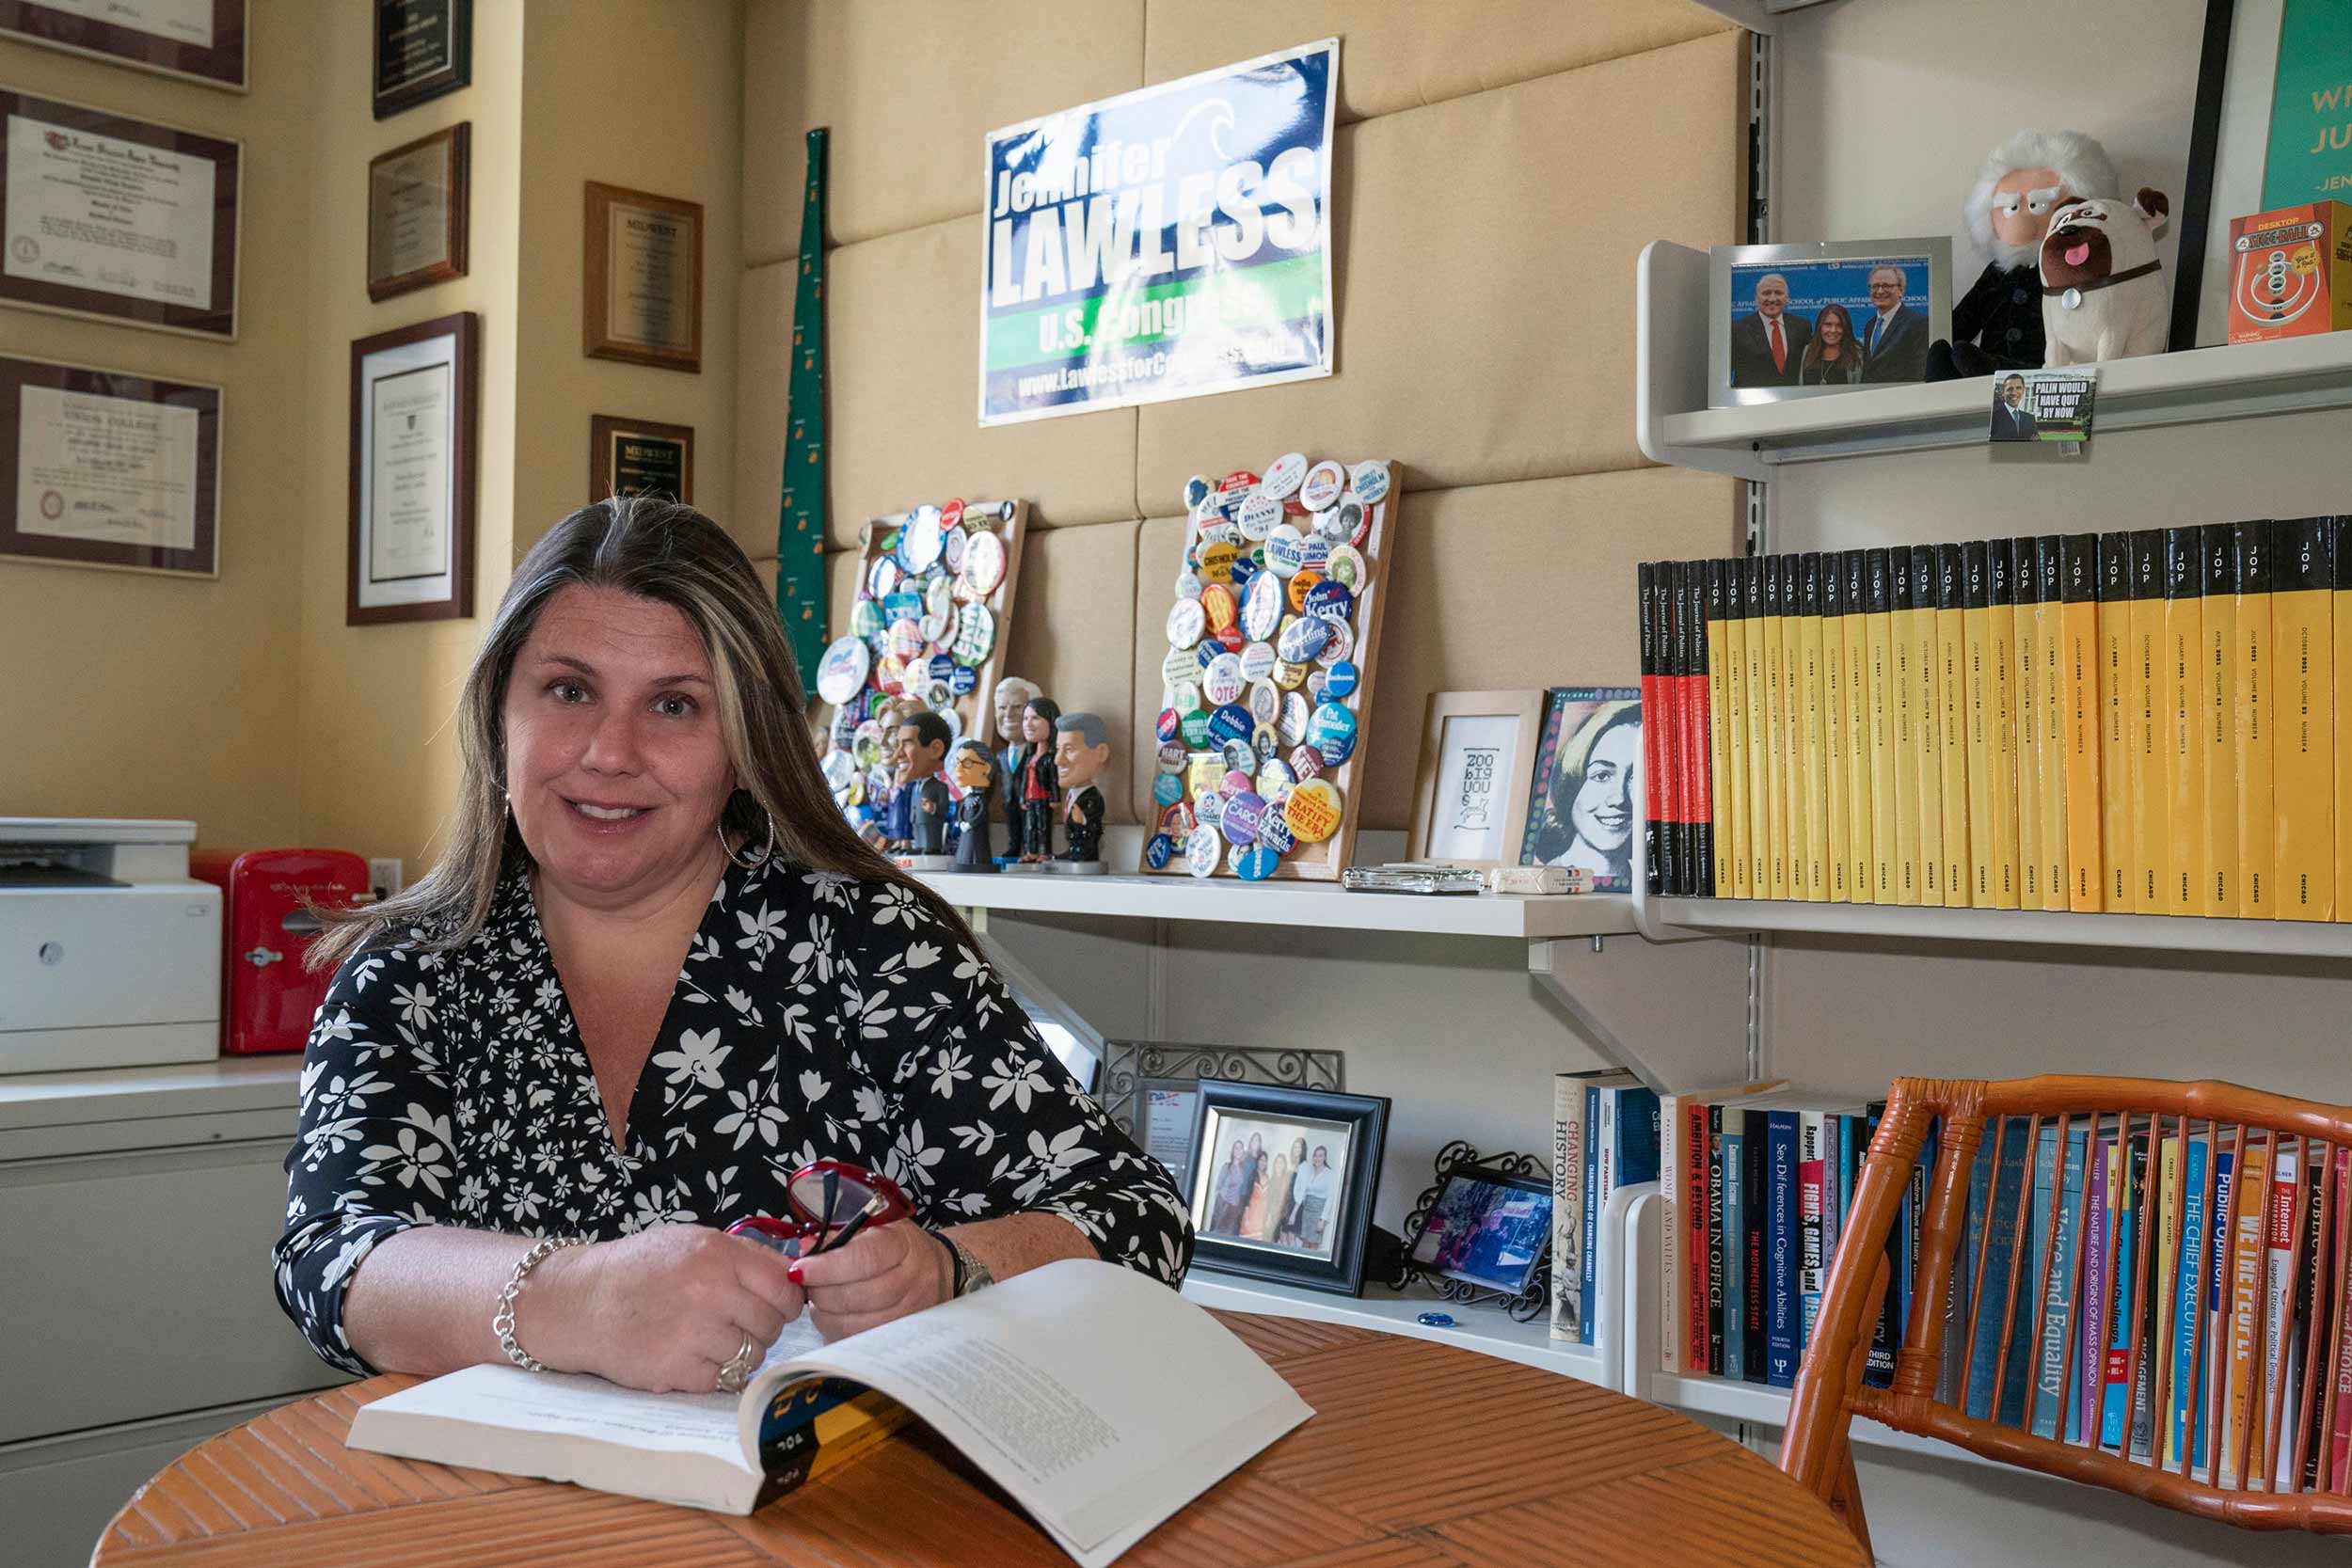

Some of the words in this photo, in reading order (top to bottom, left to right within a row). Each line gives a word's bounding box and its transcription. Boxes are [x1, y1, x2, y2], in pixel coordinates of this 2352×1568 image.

[993, 137, 1174, 217] Jennifer
[993, 147, 1321, 309] LAWLESS
[2258, 218, 2299, 231] DESKTOP
[1039, 308, 1091, 355] U.S.
[2036, 383, 2058, 393] PALIN
[2058, 382, 2088, 393] WOULD
[2040, 395, 2060, 406] HAVE
[2061, 394, 2081, 406] QUIT
[2043, 408, 2055, 419] BY
[2055, 407, 2075, 419] NOW
[1204, 552, 1237, 566] CHISHOLM
[1308, 542, 1327, 550] PAUL
[1305, 600, 1348, 618] Kerry
[1309, 592, 1328, 603] John
[1220, 709, 1247, 732] Debbie
[1263, 806, 1291, 839] Kerry
[1287, 807, 1304, 823] THE
[1306, 820, 1325, 838] ERA
[1293, 800, 1331, 827] RATIFY
[1258, 819, 1292, 852] Edwards
[1692, 1114, 1702, 1168] AMBITION
[1777, 1144, 1787, 1161] Sex
[1804, 1126, 1817, 1161] Rapoport
[1555, 1120, 1566, 1200] HISTORY
[1566, 1121, 1579, 1201] CHANGING
[1587, 1164, 1596, 1192] CHANGING
[1664, 1165, 1673, 1200] WOMEN
[1710, 1165, 1721, 1223] OBAMA
[1692, 1186, 1703, 1229] BEYOND
[1804, 1183, 1819, 1225] FIGHTS,
[2091, 1195, 2100, 1214] THE
[2187, 1193, 2201, 1221] THE
[2216, 1173, 2231, 1221] Public
[1664, 1210, 1673, 1231] AND
[2090, 1216, 2099, 1245] NATURE
[2240, 1216, 2259, 1242] WE
[2270, 1194, 2279, 1242] GENERATION
[2280, 1196, 2292, 1243] Internet
[1710, 1227, 1722, 1244] IN
[1751, 1230, 1759, 1246] THE
[1804, 1227, 1820, 1270] GAMES,
[2185, 1227, 2201, 1269] CHIEF
[1664, 1236, 1673, 1275] VALUES
[1773, 1238, 1786, 1287] Cognitive
[2090, 1247, 2099, 1267] AND
[2215, 1227, 2227, 1287] Opinion
[1710, 1251, 1722, 1307] OFFICE
[1750, 1249, 1758, 1303] MOTHERLESS
[1804, 1272, 1819, 1291] and
[2089, 1269, 2099, 1305] ORIGINS
[2269, 1259, 2280, 1289] Engaged
[1750, 1307, 1758, 1330] STATE
[1776, 1290, 1787, 1329] Abilities
[2089, 1307, 2098, 1319] OF
[2183, 1274, 2198, 1356] EXECUTIVE
[2269, 1291, 2279, 1319] Citizens
[2089, 1322, 2098, 1346] MASS
[2269, 1331, 2279, 1359] Political
[2039, 1314, 2066, 1397] Equality
[2088, 1348, 2097, 1386] OPINION
[2267, 1362, 2278, 1394] Dropouts
